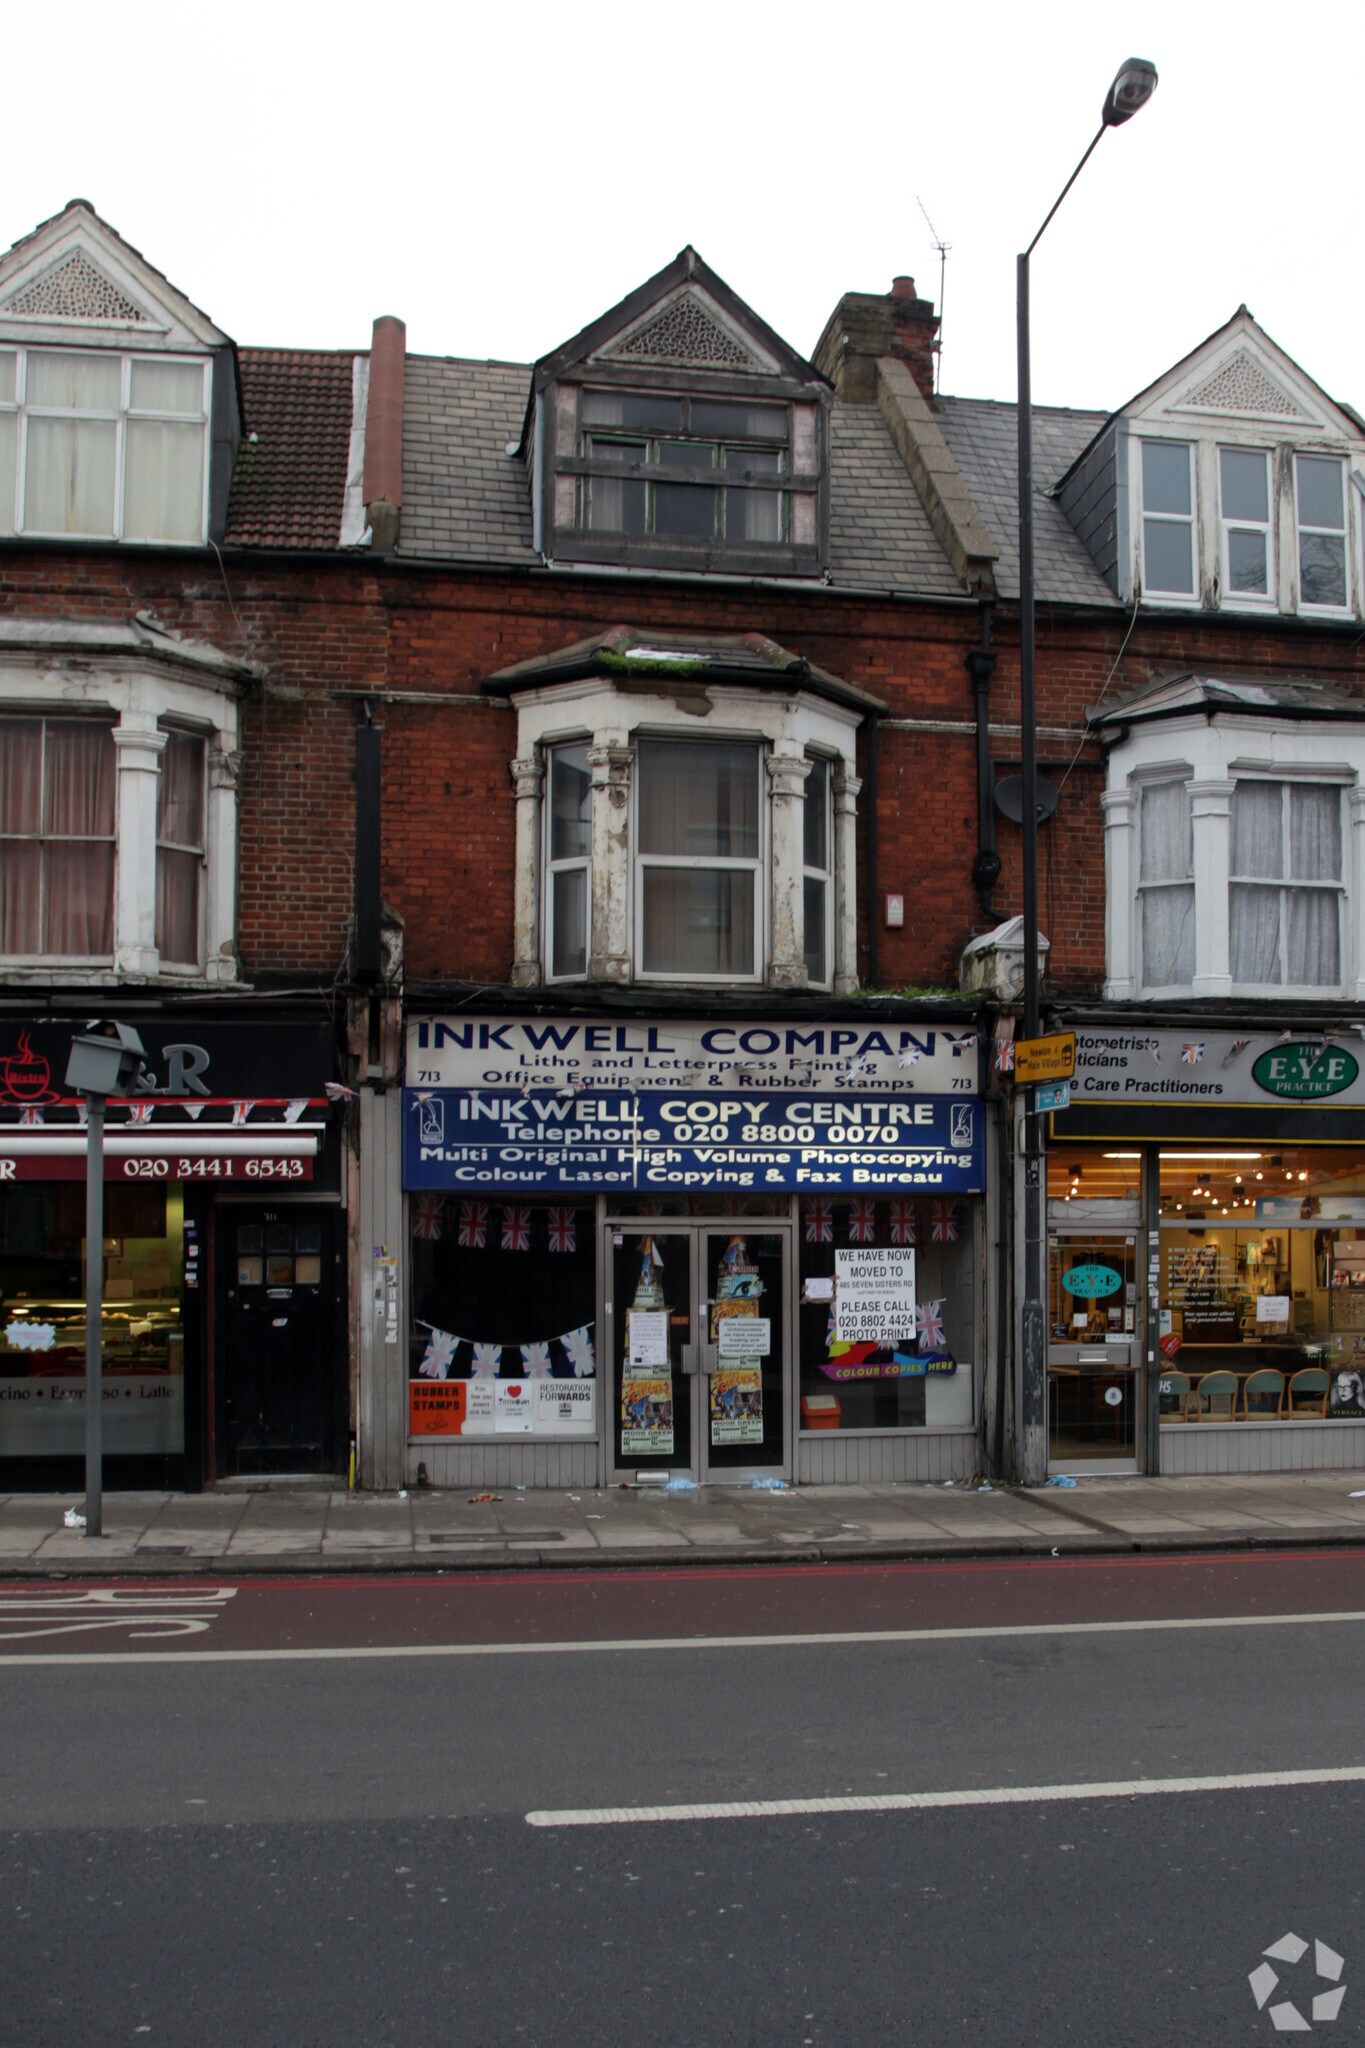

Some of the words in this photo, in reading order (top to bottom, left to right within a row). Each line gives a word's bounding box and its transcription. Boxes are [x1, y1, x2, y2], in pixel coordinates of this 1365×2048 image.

[418, 1022, 676, 1053] INKWELL
[700, 1028, 978, 1057] COMPANY
[519, 1054, 581, 1068] Litho
[592, 1056, 634, 1069] and
[645, 1057, 778, 1073] Letterpress
[1077, 1053, 1129, 1067] ticians
[10, 1072, 46, 1083] Bistro
[418, 1071, 441, 1083] 713
[482, 1071, 556, 1084] Office
[708, 1075, 724, 1087] &
[739, 1075, 822, 1088] Rubber
[835, 1076, 915, 1091] Stamps
[951, 1078, 972, 1090] 713
[1084, 1077, 1119, 1092] Care
[1125, 1079, 1223, 1098] Practitioners
[1276, 1082, 1334, 1093] PRACTICE
[460, 1098, 644, 1121] INKWELL
[659, 1101, 769, 1123] COPY
[785, 1103, 934, 1124] CENTRE
[500, 1122, 661, 1145] Telephone
[673, 1124, 729, 1142] 020
[741, 1125, 815, 1143] 8800
[827, 1125, 899, 1143] 0070
[420, 1147, 488, 1161] Multi
[500, 1147, 607, 1167] Original
[617, 1148, 682, 1167] High
[693, 1149, 791, 1163] Volume
[801, 1150, 973, 1168] Photocopying
[0, 1160, 16, 1180] R
[123, 1160, 169, 1179] 020
[177, 1160, 233, 1180] 3441
[245, 1160, 304, 1180] 6543
[455, 1167, 547, 1182] Colour
[559, 1168, 632, 1182] Laser
[646, 1168, 754, 1187] Copying
[764, 1169, 785, 1183] &
[796, 1169, 843, 1183] Fax
[852, 1169, 943, 1184] Bureau
[839, 1251, 856, 1262] WE
[858, 1251, 884, 1262] HAVE
[887, 1250, 912, 1261] NOW
[851, 1267, 887, 1278] MOVED
[891, 1266, 903, 1277] TO
[840, 1281, 850, 1289] 485
[851, 1280, 873, 1289] SEVEN
[875, 1280, 901, 1288] SISTERS
[903, 1280, 913, 1288] RD
[841, 1301, 881, 1312] PLEASE
[883, 1300, 910, 1311] CALL
[839, 1317, 858, 1328] 020
[861, 1316, 885, 1327] 8802
[888, 1315, 914, 1326] 4424
[843, 1330, 878, 1341] PROTO
[880, 1328, 910, 1340] PRINT
[836, 1367, 881, 1378] COLOUR
[885, 1364, 924, 1375] COPIES
[928, 1361, 953, 1371] HERE
[51, 1386, 120, 1402] Esprso
[139, 1384, 174, 1400] Latte
[414, 1386, 459, 1397] RUBBER
[540, 1384, 592, 1392] RESTORATION
[1159, 1380, 1172, 1393] HS
[540, 1392, 592, 1402] FORWARDS
[414, 1400, 460, 1412] STAMPS
